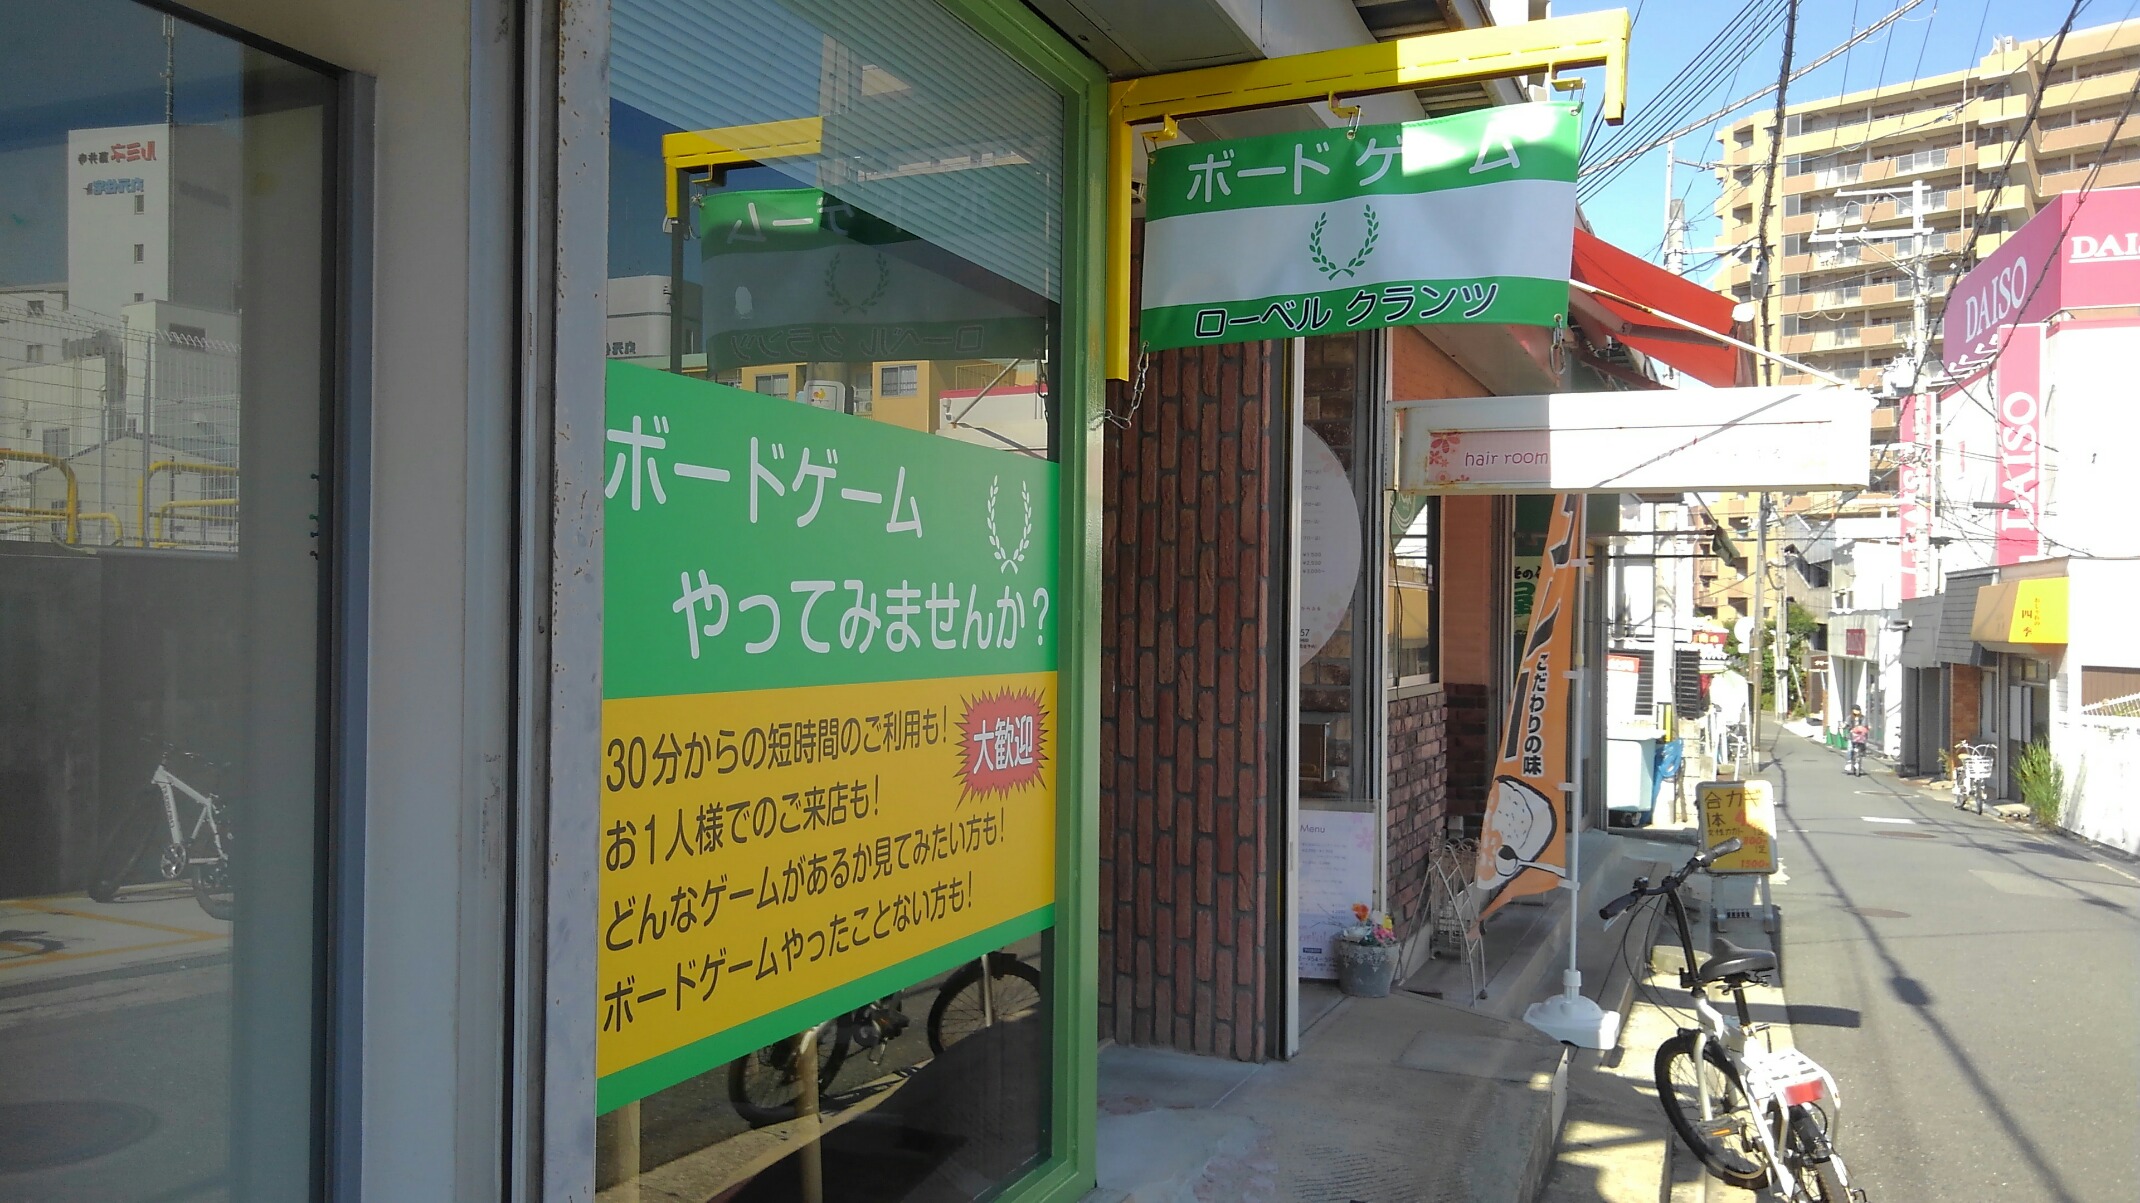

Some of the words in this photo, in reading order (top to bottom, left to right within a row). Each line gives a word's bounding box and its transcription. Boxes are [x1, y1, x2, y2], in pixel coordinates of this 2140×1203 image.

[1186, 119, 1520, 202] ボードゲム
[2070, 232, 2140, 259] DAI
[1194, 296, 1333, 339] ローベル
[1346, 282, 1499, 327] クランツ
[1965, 256, 2027, 343] DAISO
[604, 415, 923, 538] ボードゲーム
[1465, 451, 1500, 467] hair
[1504, 452, 1549, 466] room
[2002, 392, 2037, 531] DAISO
[673, 569, 1049, 660] やってみませんか?
[973, 714, 1034, 774] 大歓迎
[1523, 654, 1548, 775] こだわりの味
[1300, 824, 1326, 834] Menu
